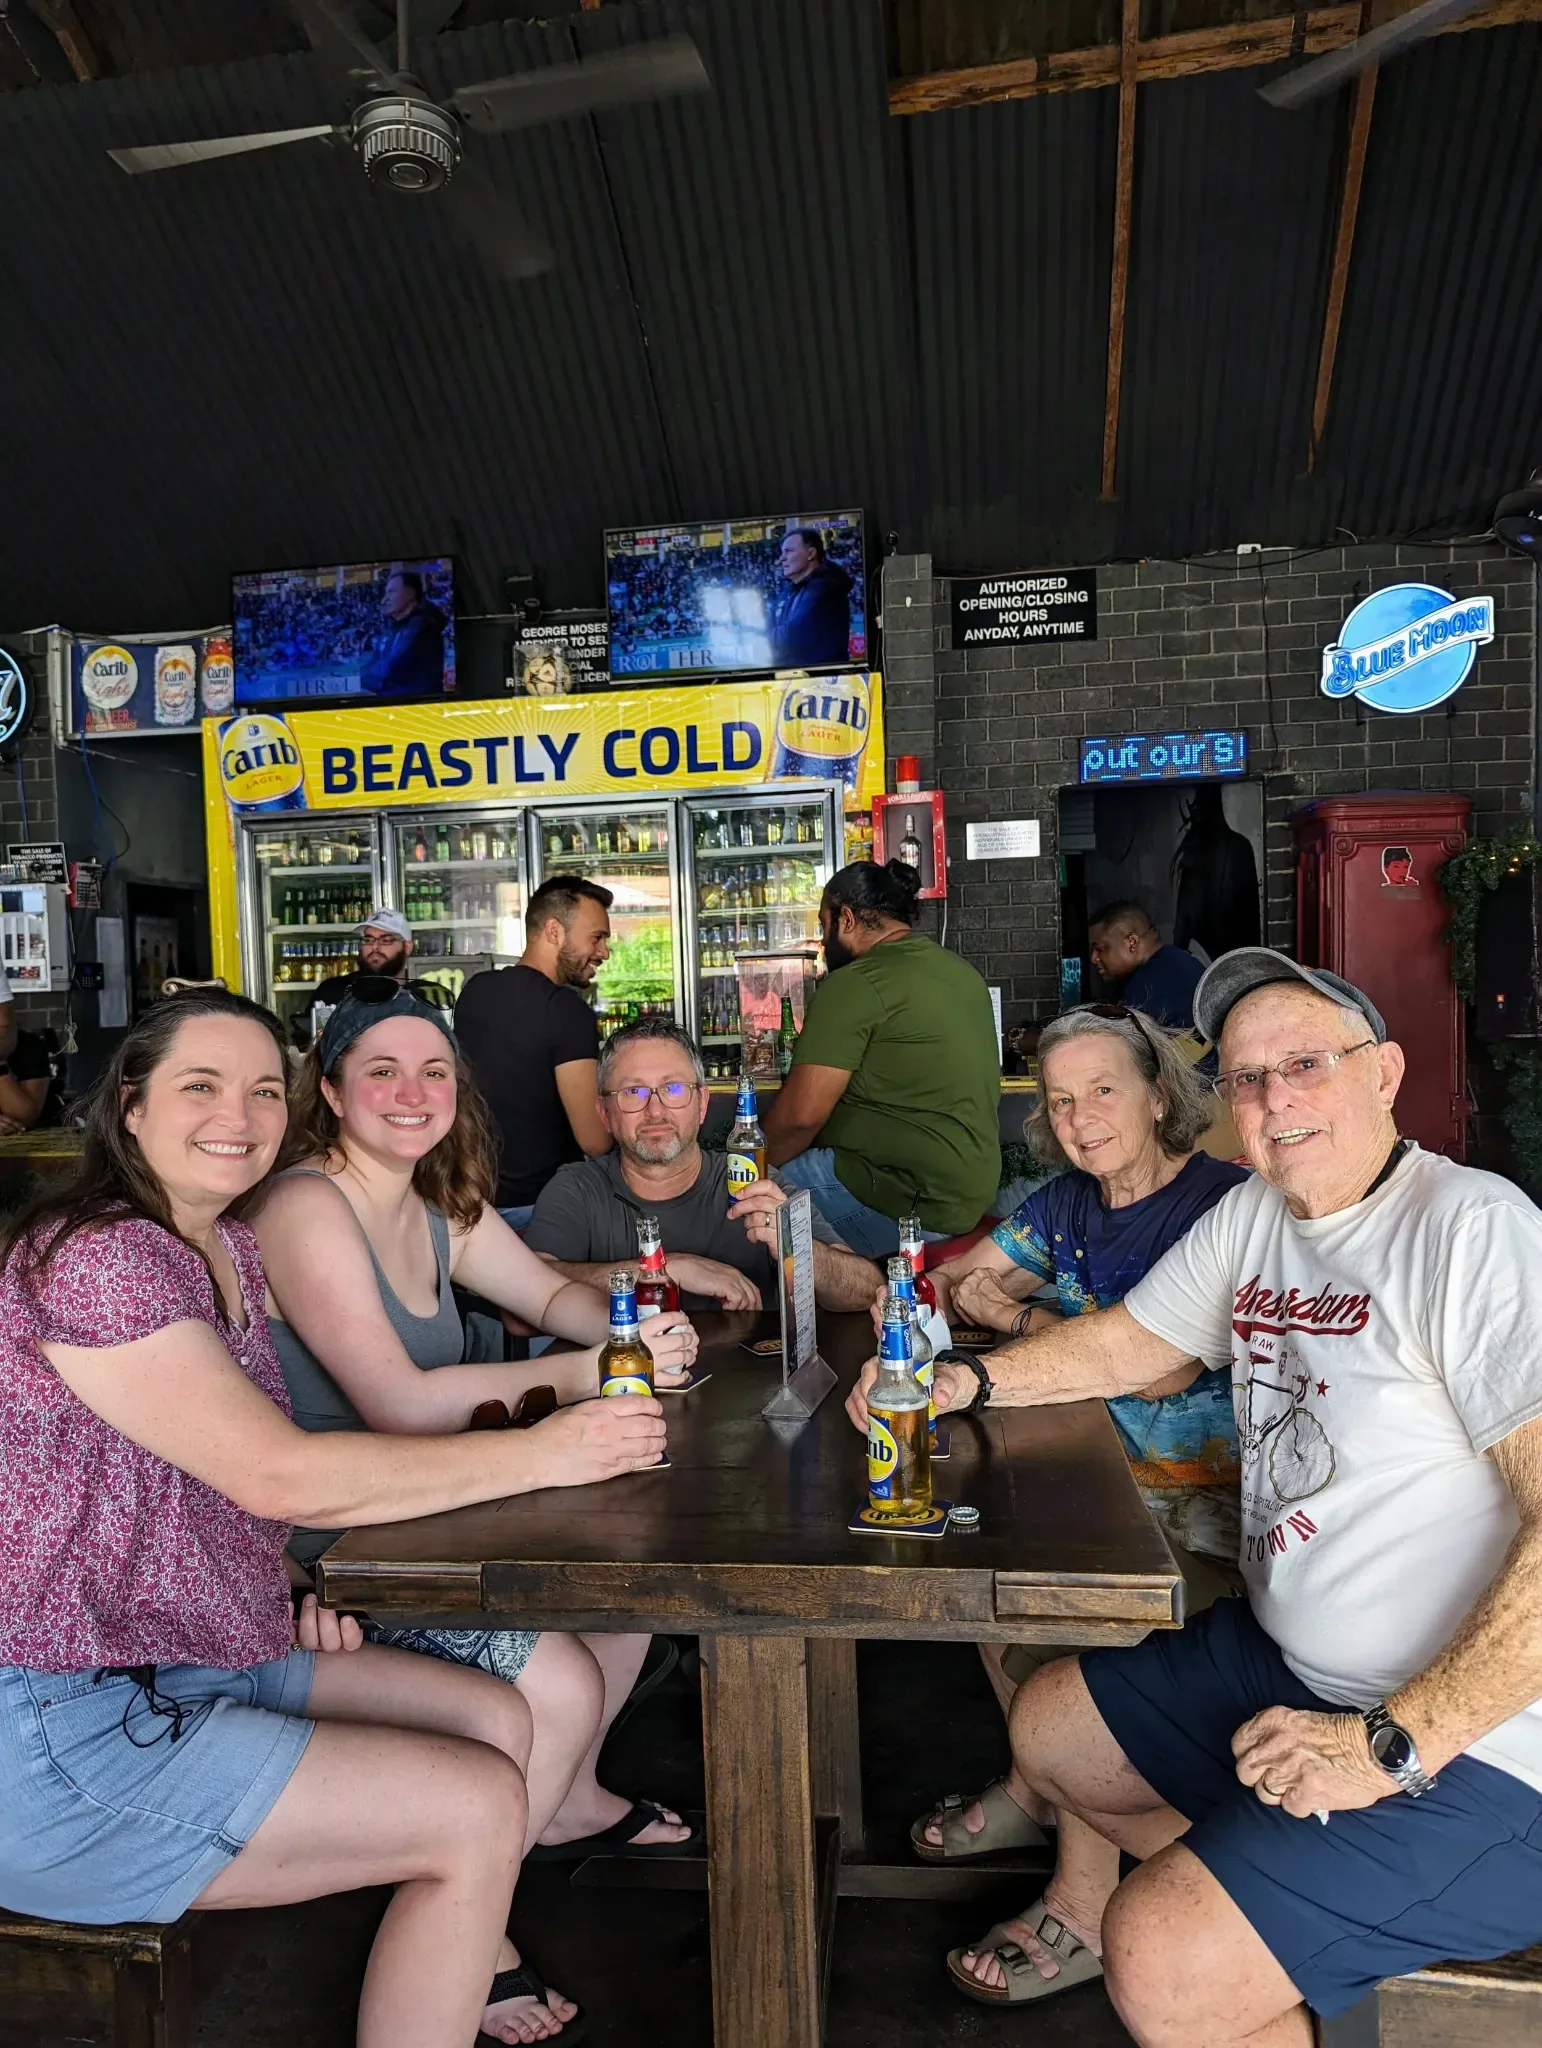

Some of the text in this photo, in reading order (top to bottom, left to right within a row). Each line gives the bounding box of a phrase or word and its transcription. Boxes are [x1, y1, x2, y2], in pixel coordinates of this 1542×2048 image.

[979, 577, 1068, 595] AUTHORIZED
[959, 591, 1088, 611] OPENING/CLOSING
[999, 609, 1048, 624] HOURS
[521, 623, 608, 638] GEORGE MOSES
[964, 621, 1084, 641] ANYDAY, ANYTIME
[571, 636, 586, 647] TO
[588, 635, 609, 646] SEL
[1326, 605, 1488, 694] BLUE MOON
[93, 660, 129, 677] Carib
[164, 671, 187, 682] Carib
[206, 666, 232, 679] Carib
[783, 689, 867, 731] Carib
[801, 730, 841, 743] LAGER
[222, 737, 298, 781] Carib
[322, 721, 763, 794] BEASTLY COLD
[1150, 743, 1205, 766] our
[246, 774, 283, 789] LAGER
[728, 1168, 755, 1182] arib
[868, 1440, 893, 1462] rib
